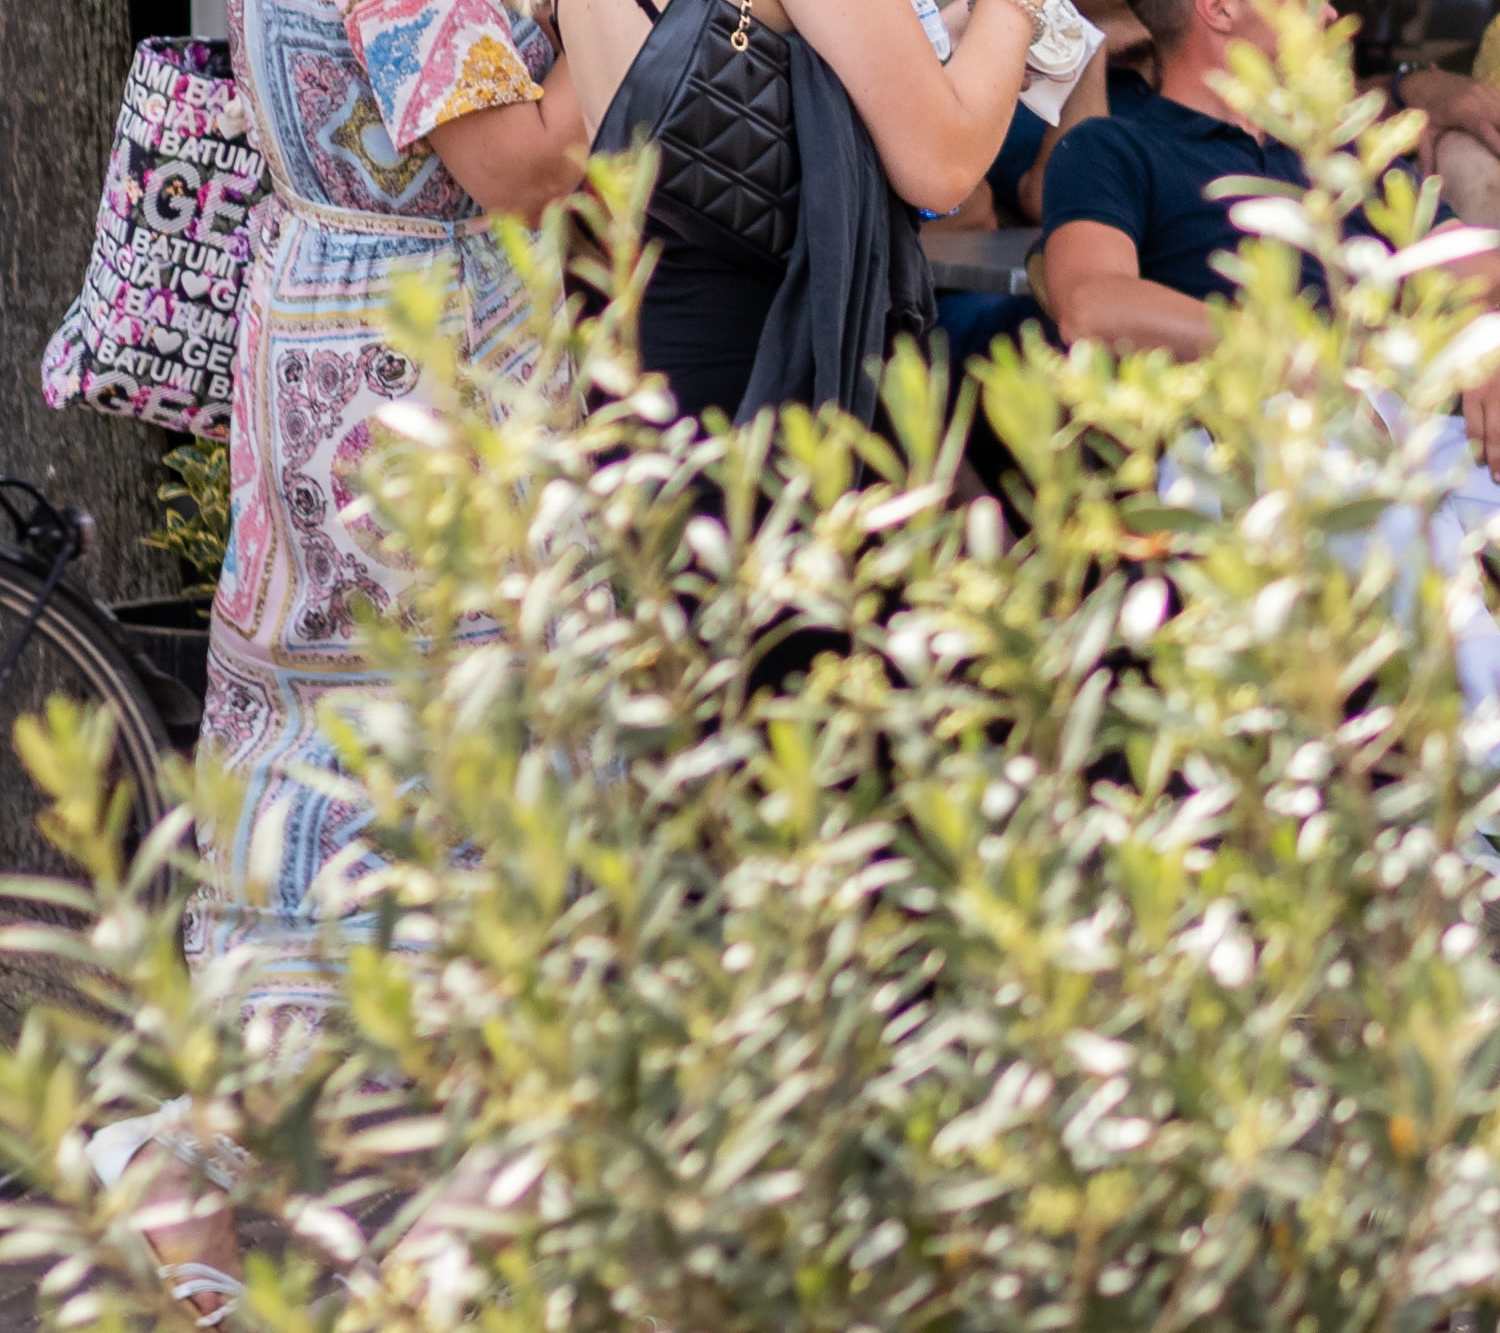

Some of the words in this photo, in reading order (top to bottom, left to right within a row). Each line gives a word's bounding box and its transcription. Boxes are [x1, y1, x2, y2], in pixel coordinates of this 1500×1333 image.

[158, 129, 267, 182] BATUMI
[131, 225, 238, 279] BATUMI
[96, 336, 205, 393] BATUMI
[181, 336, 237, 375] GE
